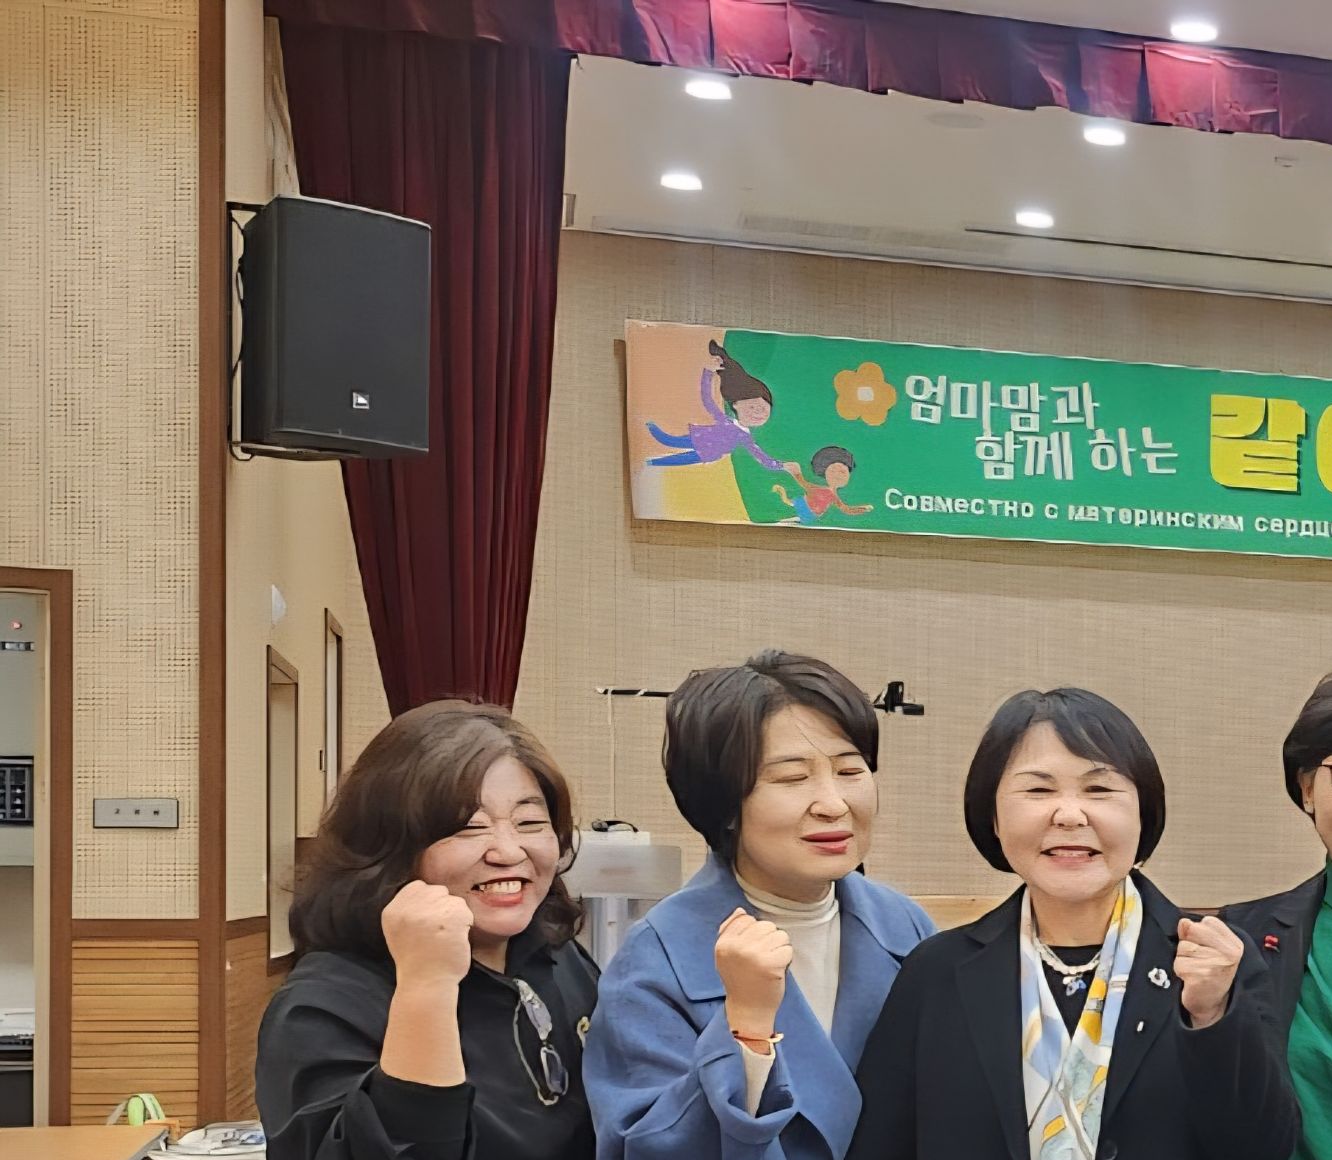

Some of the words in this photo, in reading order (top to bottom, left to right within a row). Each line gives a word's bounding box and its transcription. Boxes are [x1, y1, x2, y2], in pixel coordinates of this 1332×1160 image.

[905, 374, 1101, 433] 엄마맘과
[975, 431, 1074, 480] 함께
[1088, 427, 1180, 476] 하는
[885, 488, 1034, 518] Совместно
